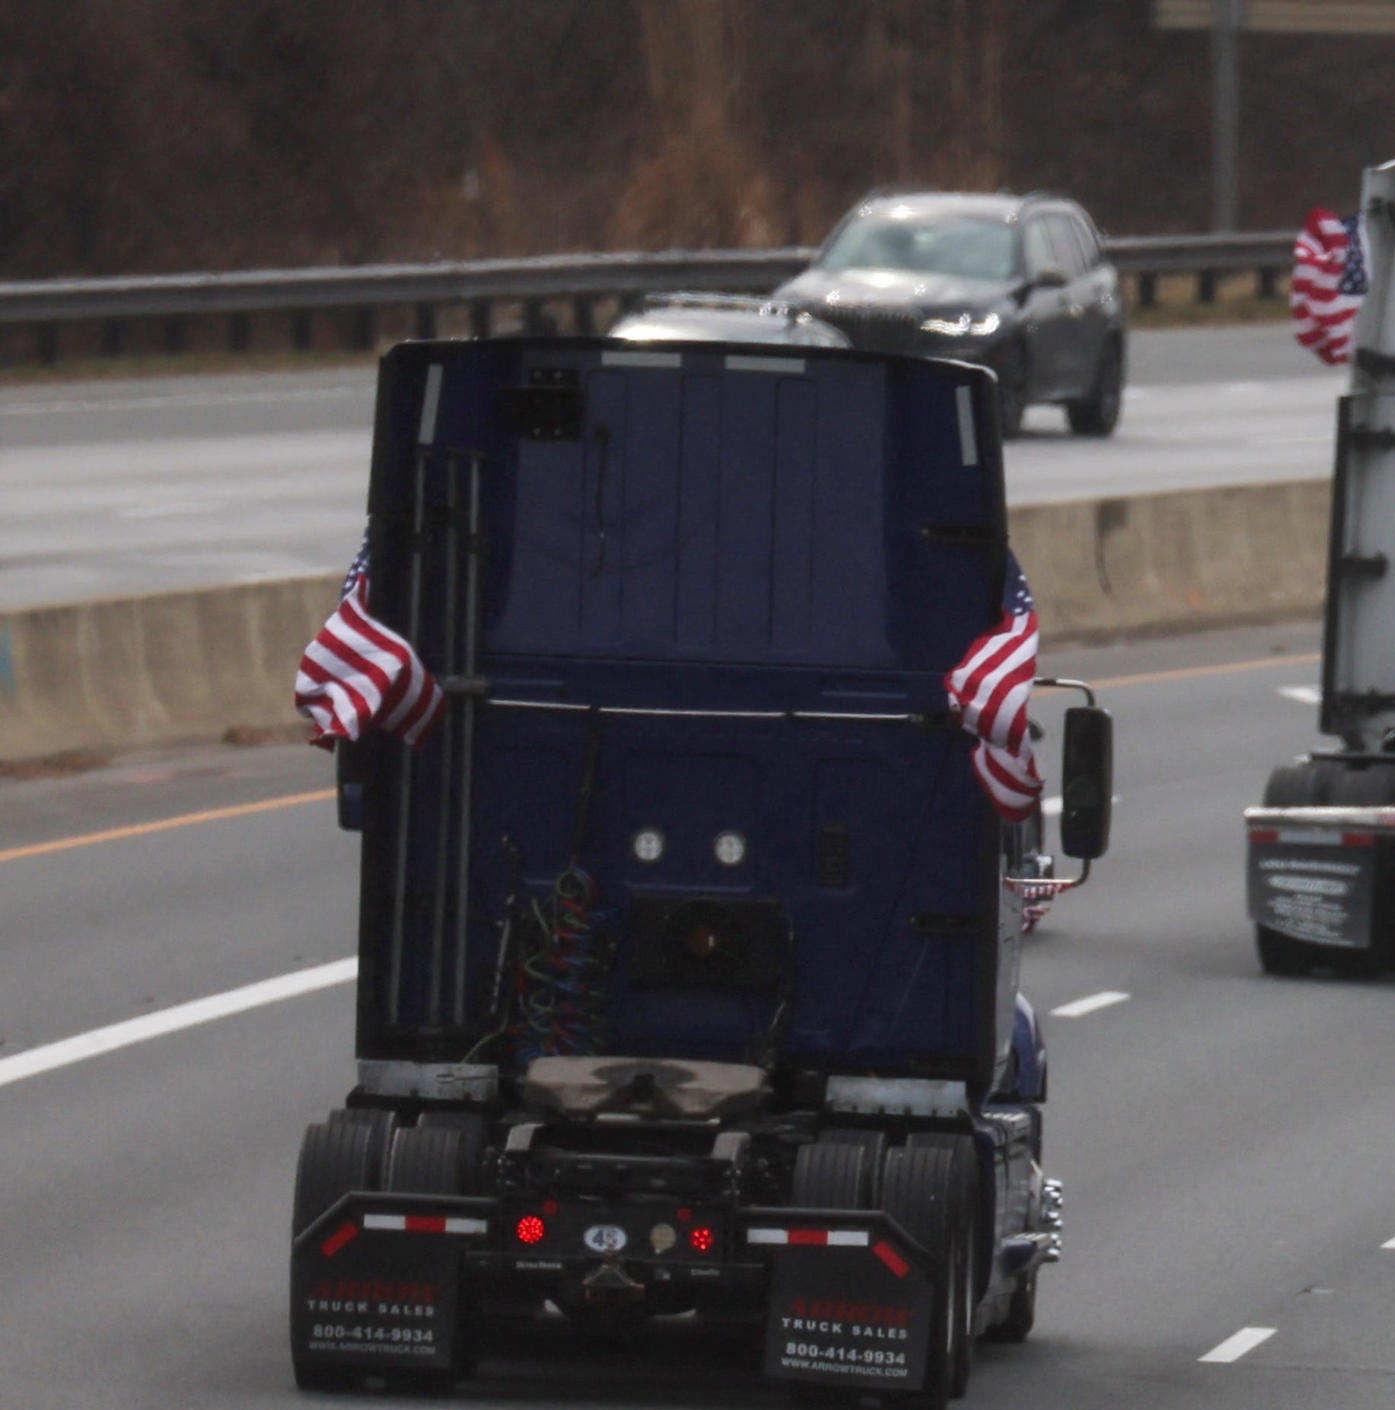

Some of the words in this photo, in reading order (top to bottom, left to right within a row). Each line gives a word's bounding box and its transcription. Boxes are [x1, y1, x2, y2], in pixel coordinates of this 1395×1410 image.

[307, 1300, 368, 1313] TRUCK
[378, 1303, 435, 1317] SALES
[312, 1323, 434, 1343] 800-414-9934
[781, 1317, 843, 1334] TRUCK
[852, 1324, 908, 1340] SALES
[785, 1341, 906, 1365] 800-414-9934
